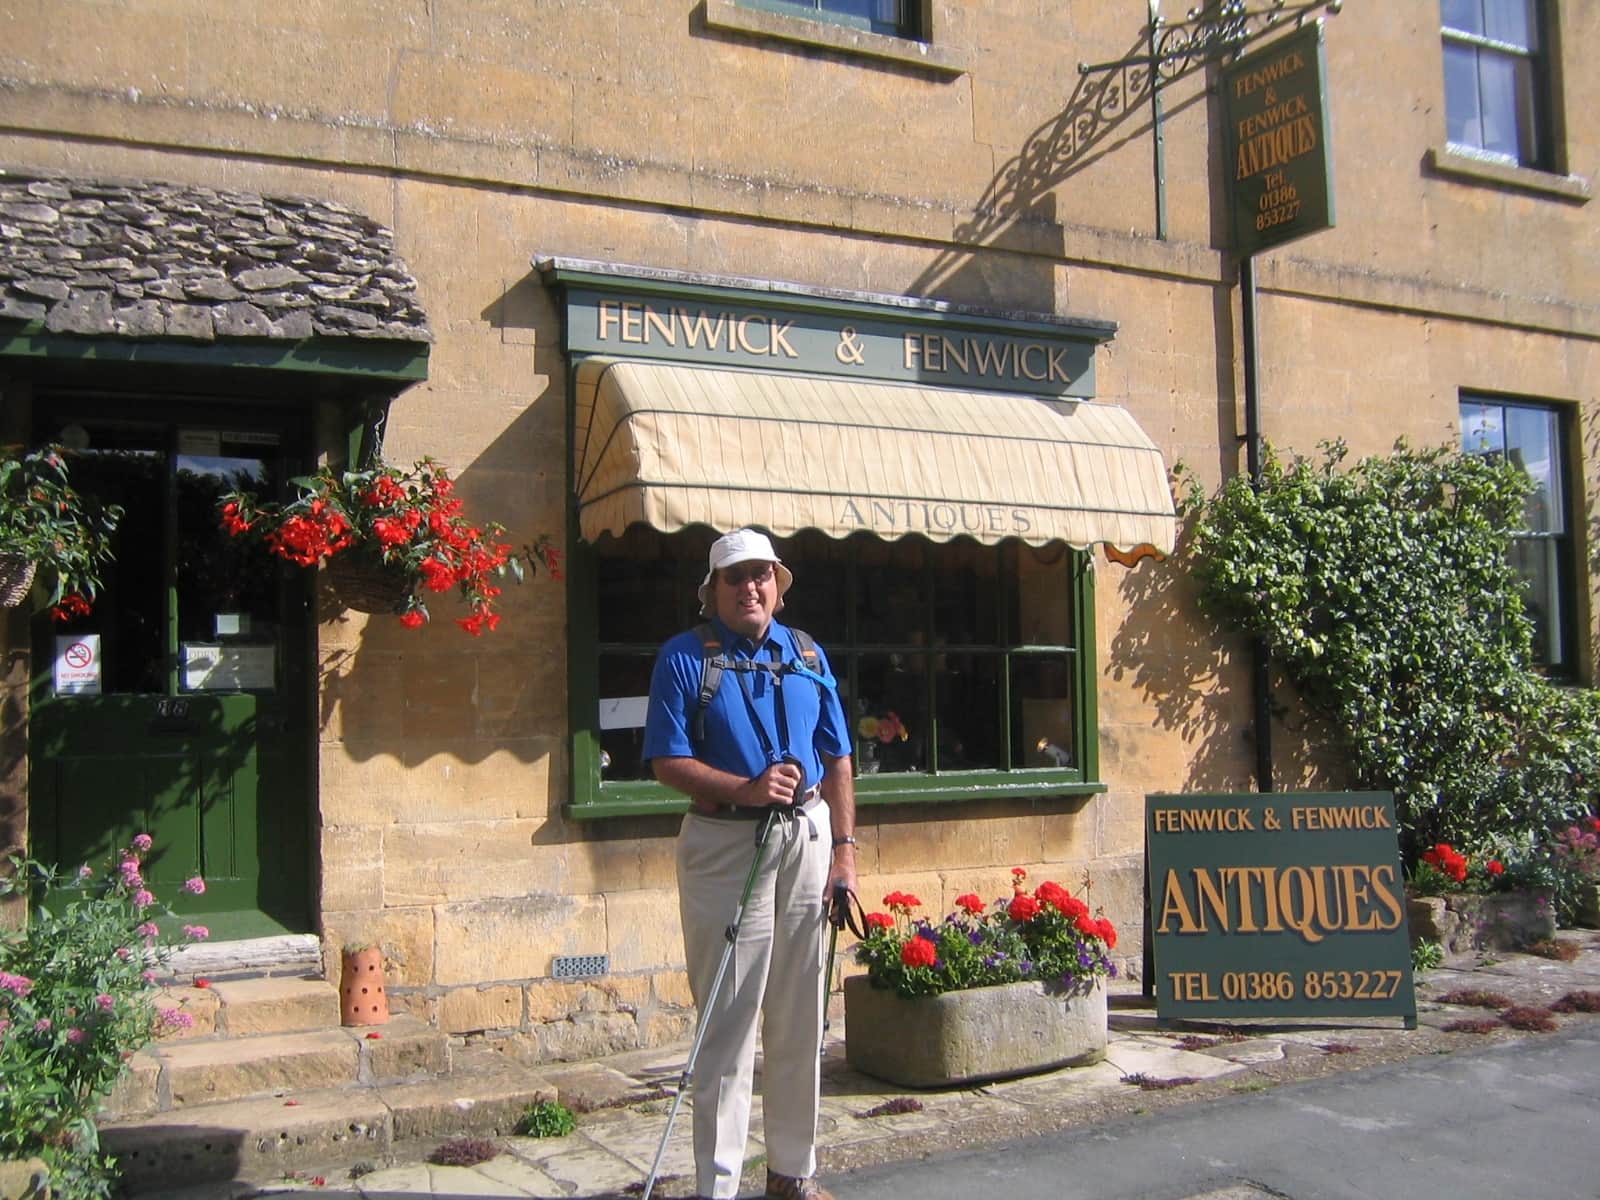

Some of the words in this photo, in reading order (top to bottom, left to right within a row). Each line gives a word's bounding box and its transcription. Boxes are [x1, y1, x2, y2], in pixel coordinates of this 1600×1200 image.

[1236, 52, 1304, 97] FENWICK
[1265, 88, 1277, 104] &
[1239, 96, 1307, 139] FENWICK
[1237, 113, 1316, 179] ANTIQUES
[1256, 201, 1300, 231] 853227
[1259, 188, 1296, 210] 01386
[598, 300, 799, 357] FENWICK
[836, 326, 865, 364] &
[903, 332, 1071, 383] FENWICK
[839, 499, 1032, 533] ANTIQUES
[1154, 808, 1255, 832] FENWICK
[1263, 807, 1281, 830] &
[1292, 806, 1391, 830] FENWICK
[1157, 864, 1402, 942] ANTIQUES
[1168, 972, 1219, 1000] TEL
[1222, 971, 1294, 1000] 01386
[1304, 970, 1402, 999] 853227
